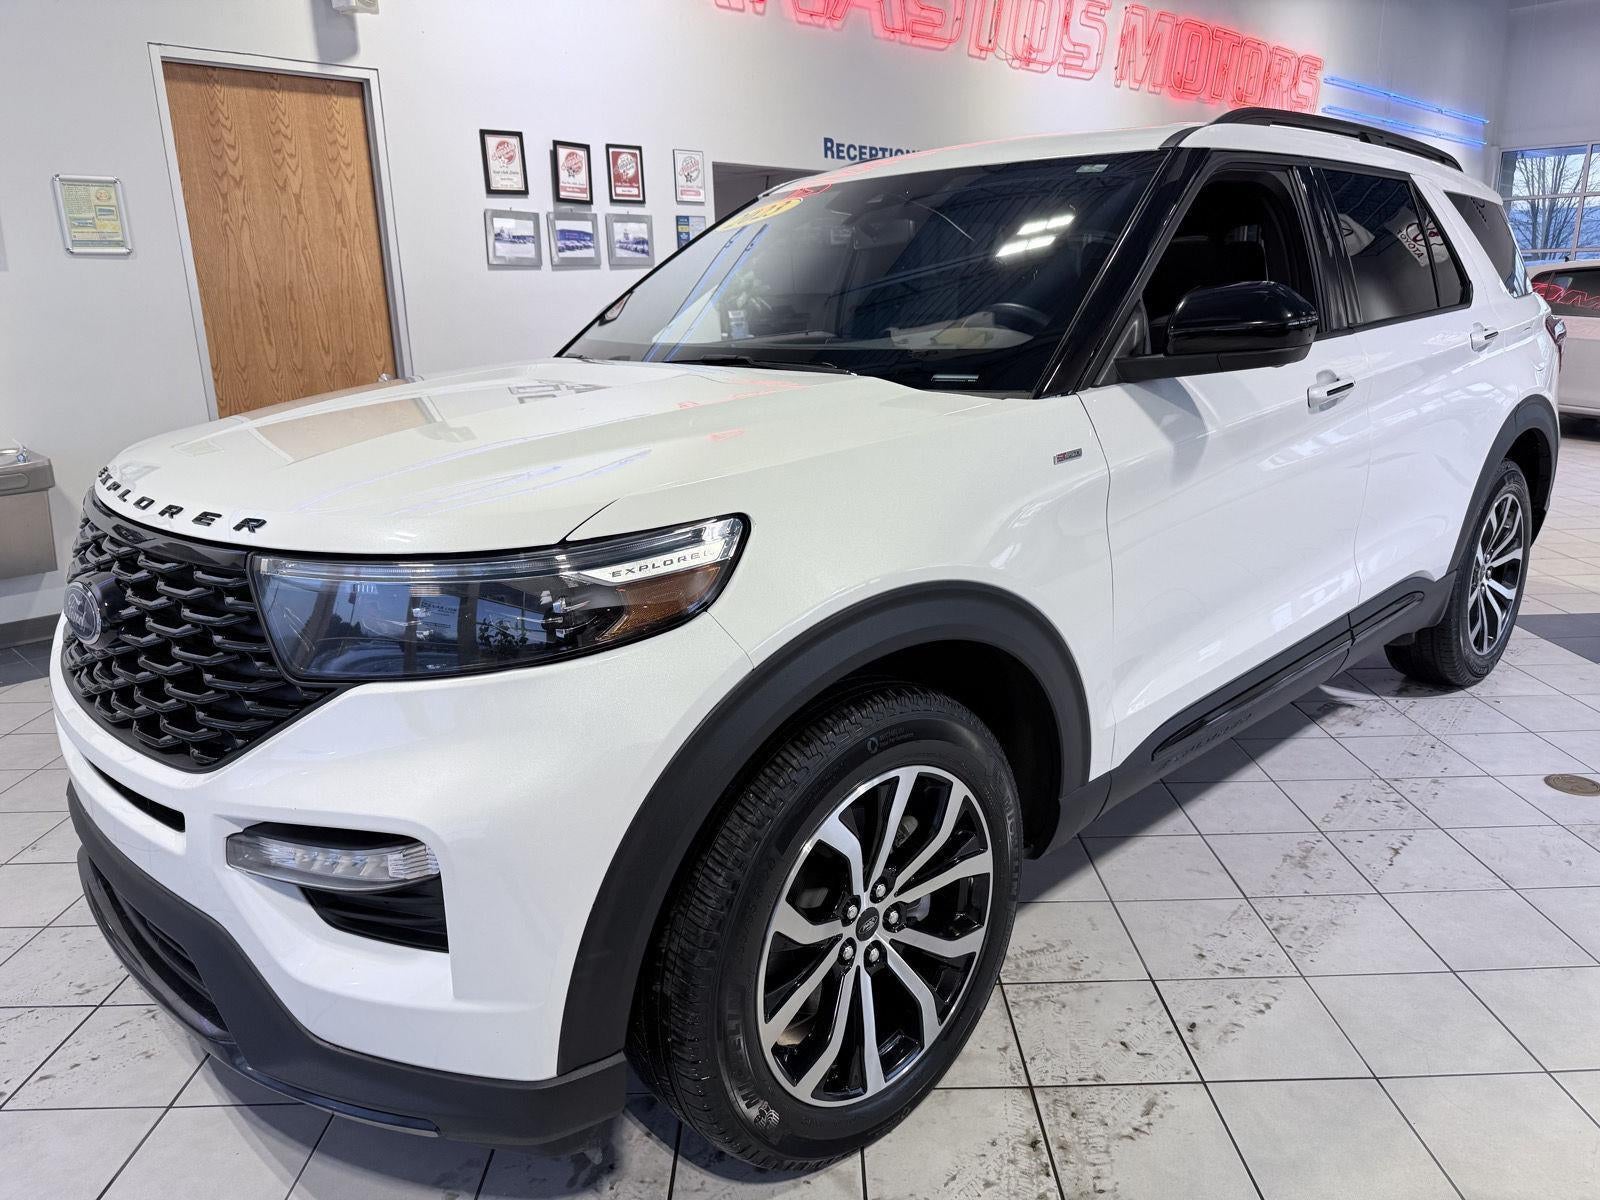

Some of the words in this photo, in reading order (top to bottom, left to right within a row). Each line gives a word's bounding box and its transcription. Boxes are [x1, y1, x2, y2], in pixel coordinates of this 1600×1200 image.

[1114, 3, 1324, 112] MOTORS
[1396, 228, 1424, 258] TOYOTA
[98, 466, 267, 533] EXPLORER
